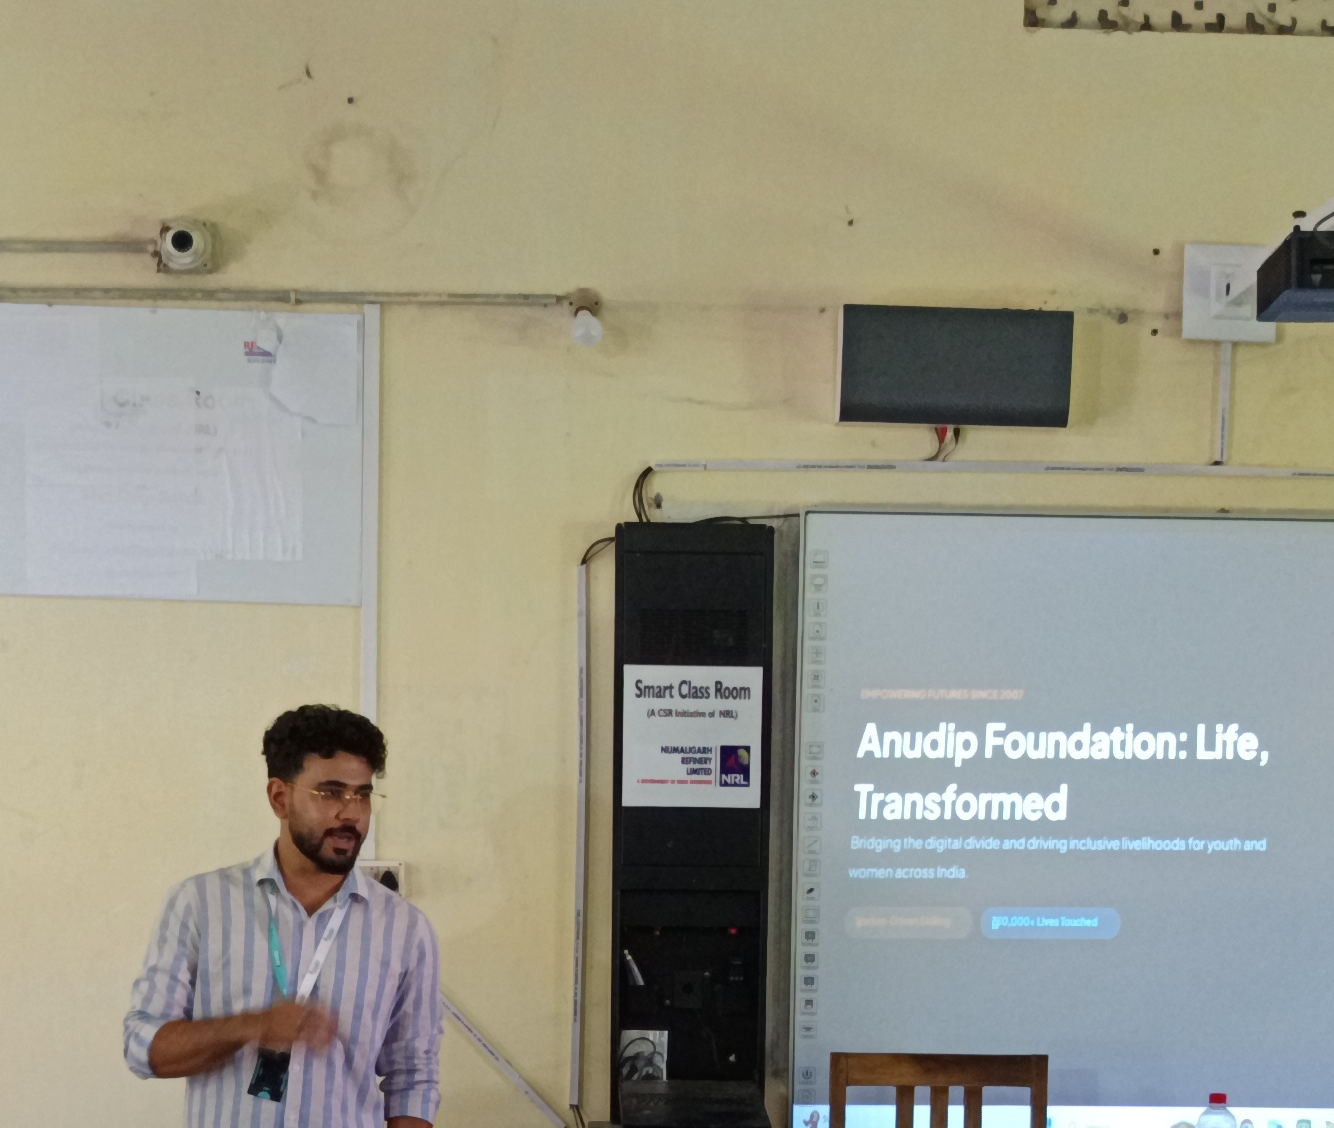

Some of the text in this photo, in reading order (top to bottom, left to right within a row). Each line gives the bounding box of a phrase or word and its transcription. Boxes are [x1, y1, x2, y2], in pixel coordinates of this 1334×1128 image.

[634, 679, 751, 700] Smart Class Room
[647, 709, 738, 720] (A CSR Initiative of NRL)
[856, 722, 1269, 767] Anudip Foundation: Life,
[681, 757, 712, 765] REFINERY
[721, 774, 748, 785] NRL
[854, 783, 1068, 821] Transformed
[850, 836, 1267, 854] Bridging the digital divide and driving inclusive livelihoods for youth and
[848, 865, 968, 879] women across India.
[1061, 917, 1098, 927] Touched
